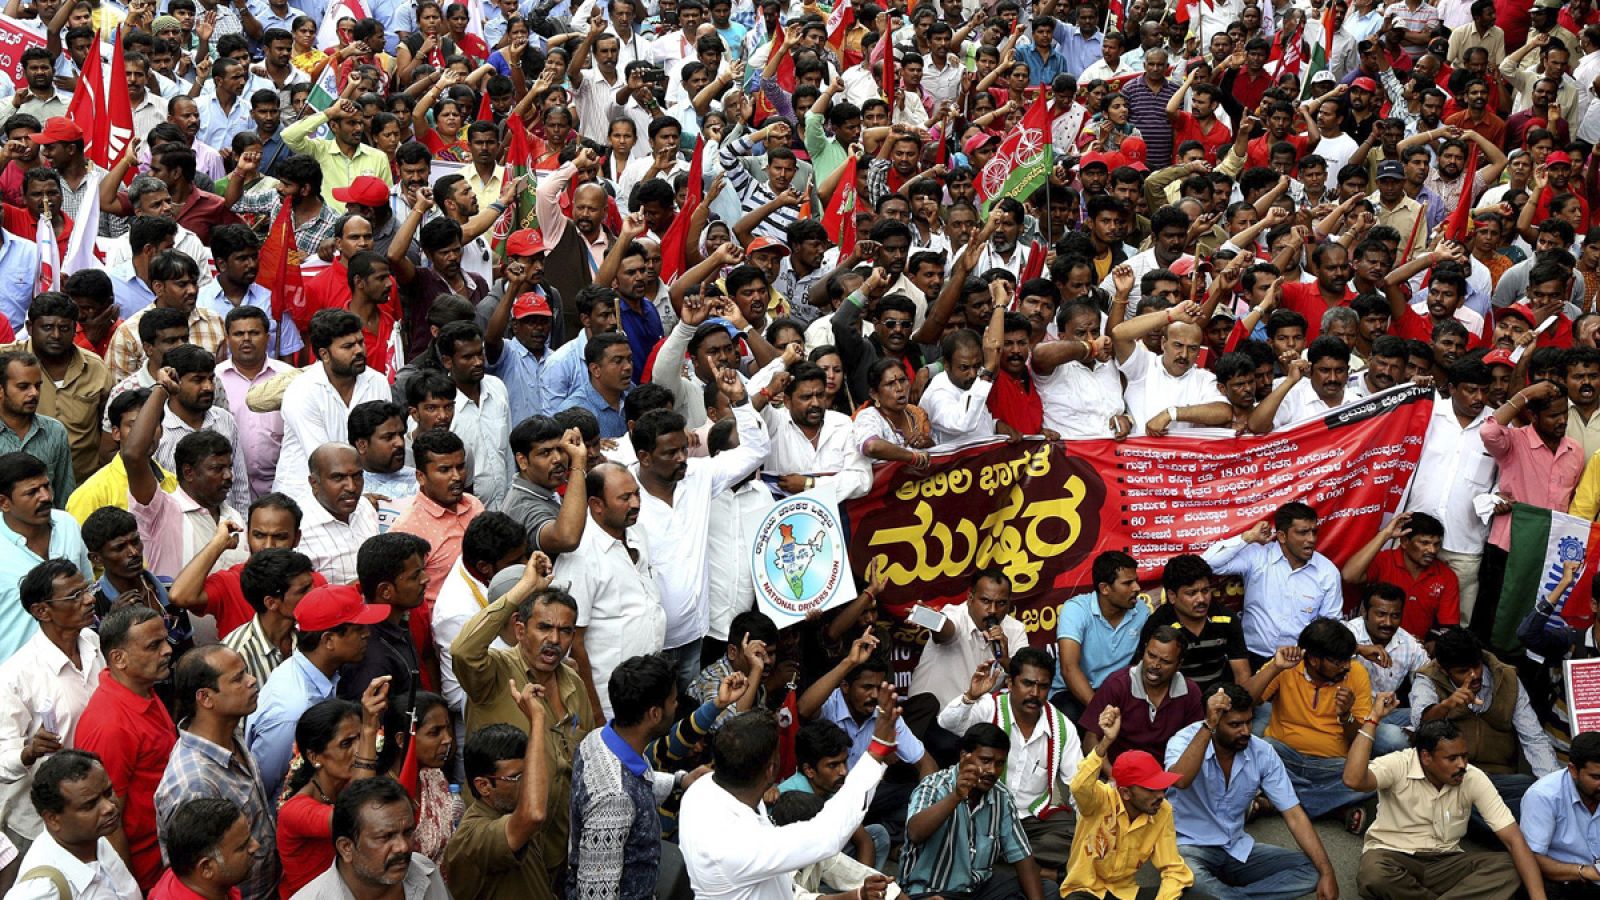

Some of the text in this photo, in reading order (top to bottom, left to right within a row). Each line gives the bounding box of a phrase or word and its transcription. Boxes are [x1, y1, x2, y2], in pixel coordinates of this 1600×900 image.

[896, 467, 972, 500] ಅಖಿಲ
[1220, 463, 1259, 479] 18.000
[863, 474, 1087, 594] ಮುಷ್ಕರ
[1131, 516, 1146, 527] 60
[763, 560, 839, 612] NATIONAL DRIVERS UNION
